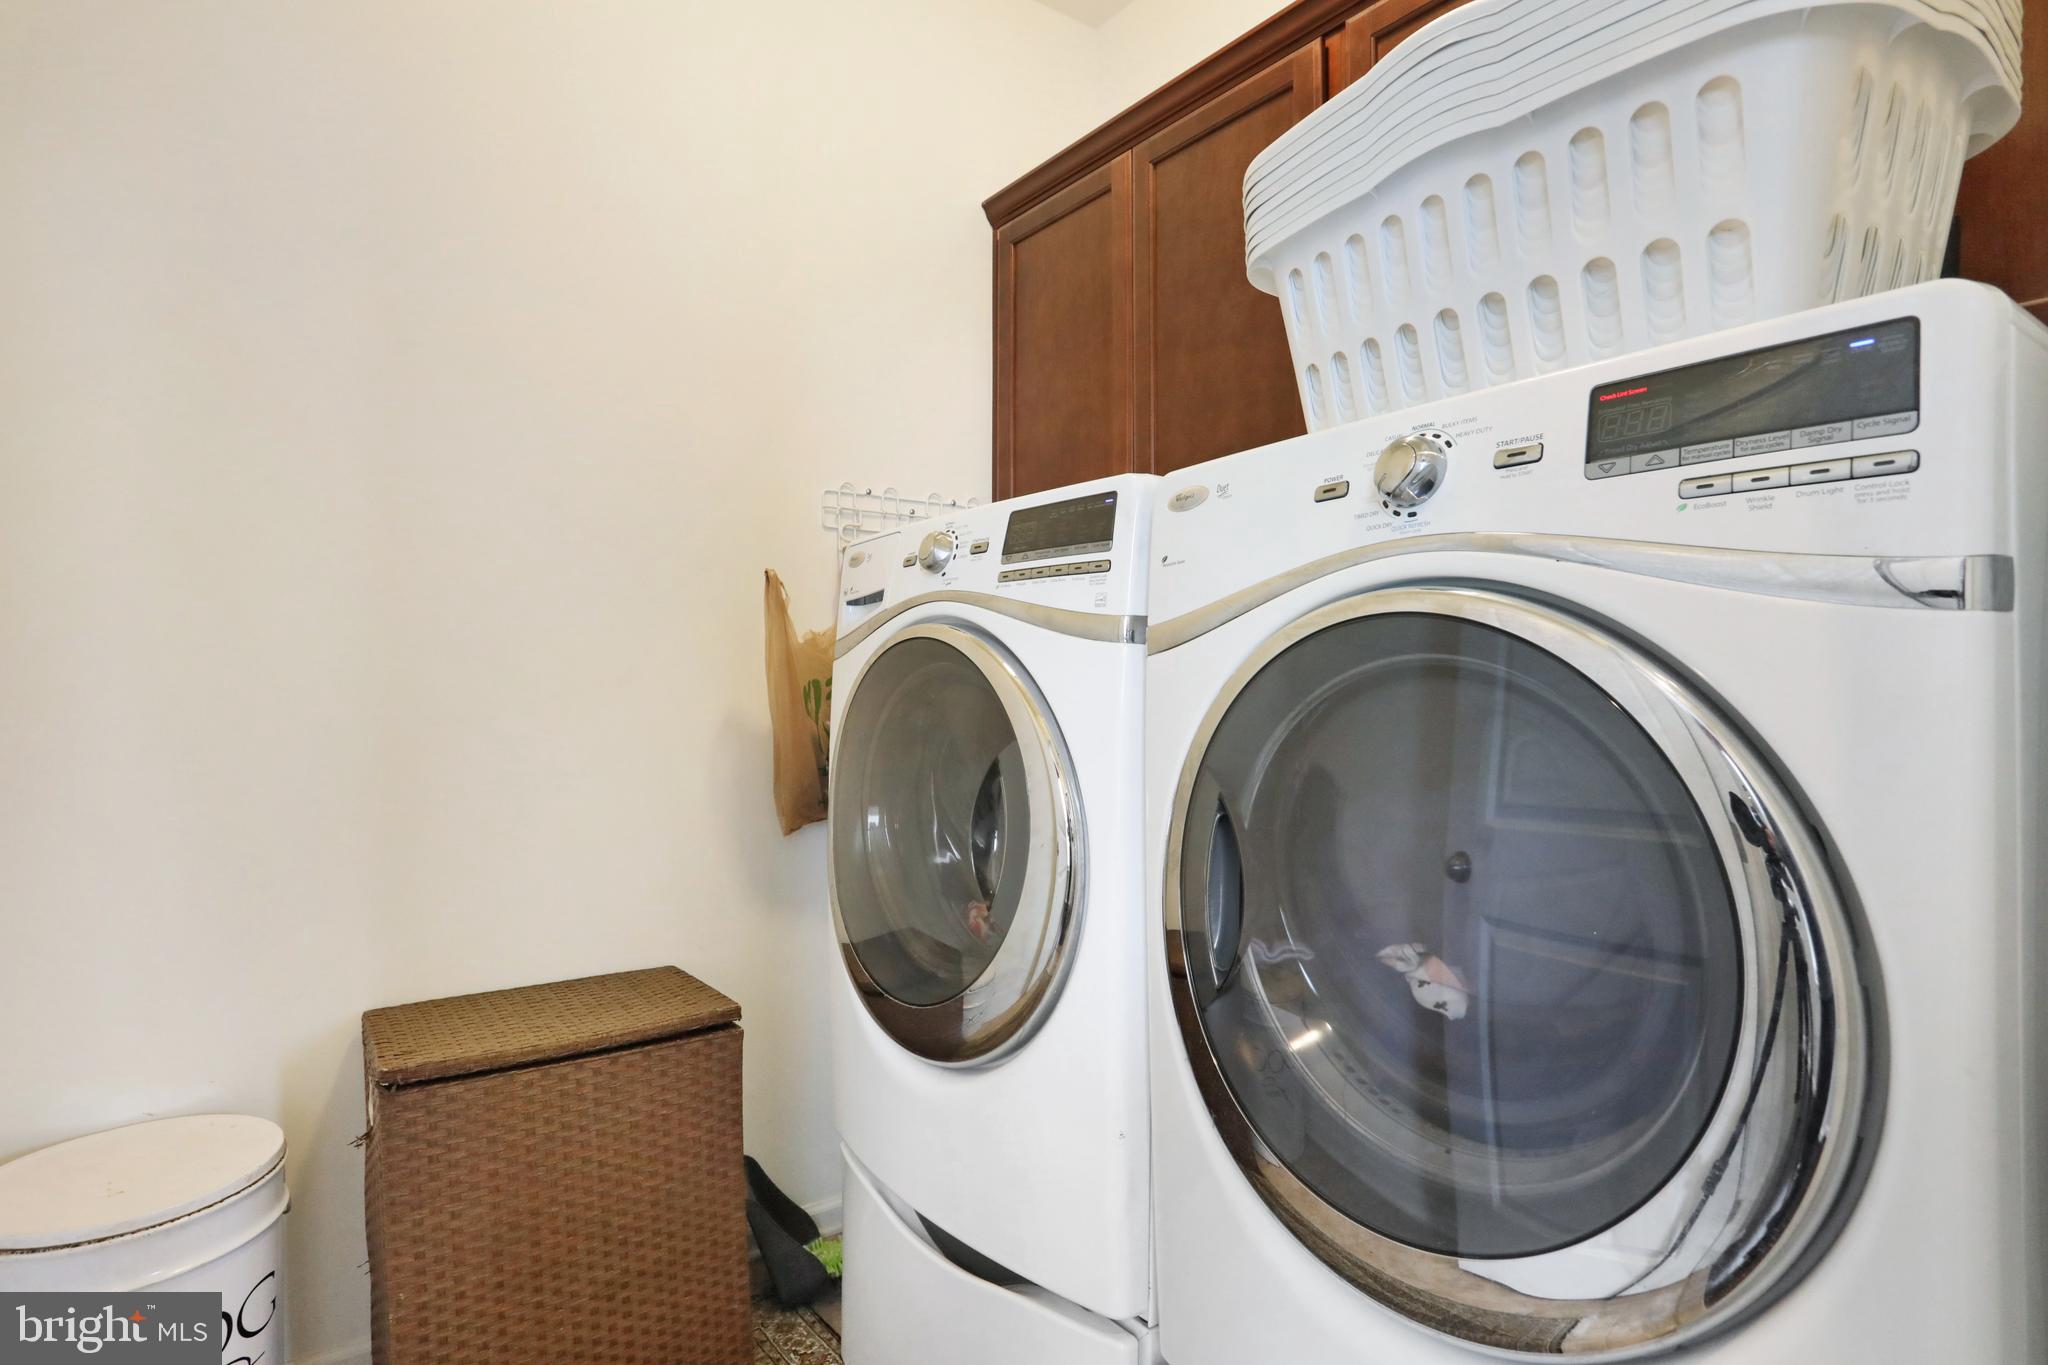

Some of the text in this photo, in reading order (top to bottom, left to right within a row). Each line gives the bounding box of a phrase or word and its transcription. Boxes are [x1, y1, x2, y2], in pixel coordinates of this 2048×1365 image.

[1411, 422, 1436, 432] NORMAL
[1856, 415, 1912, 432] Cycle Signal
[1455, 426, 1494, 439] HEAVY DUTY
[1800, 425, 1843, 440] Damp Dry
[1495, 432, 1544, 449] START/PAUSE
[1735, 433, 1790, 449] Dryness Level
[1683, 443, 1730, 456] Temperature
[1323, 474, 1345, 484] POWER
[1854, 479, 1910, 492] Control Lock
[1795, 486, 1845, 499] Drum Light
[1744, 495, 1775, 504] Wrinkle
